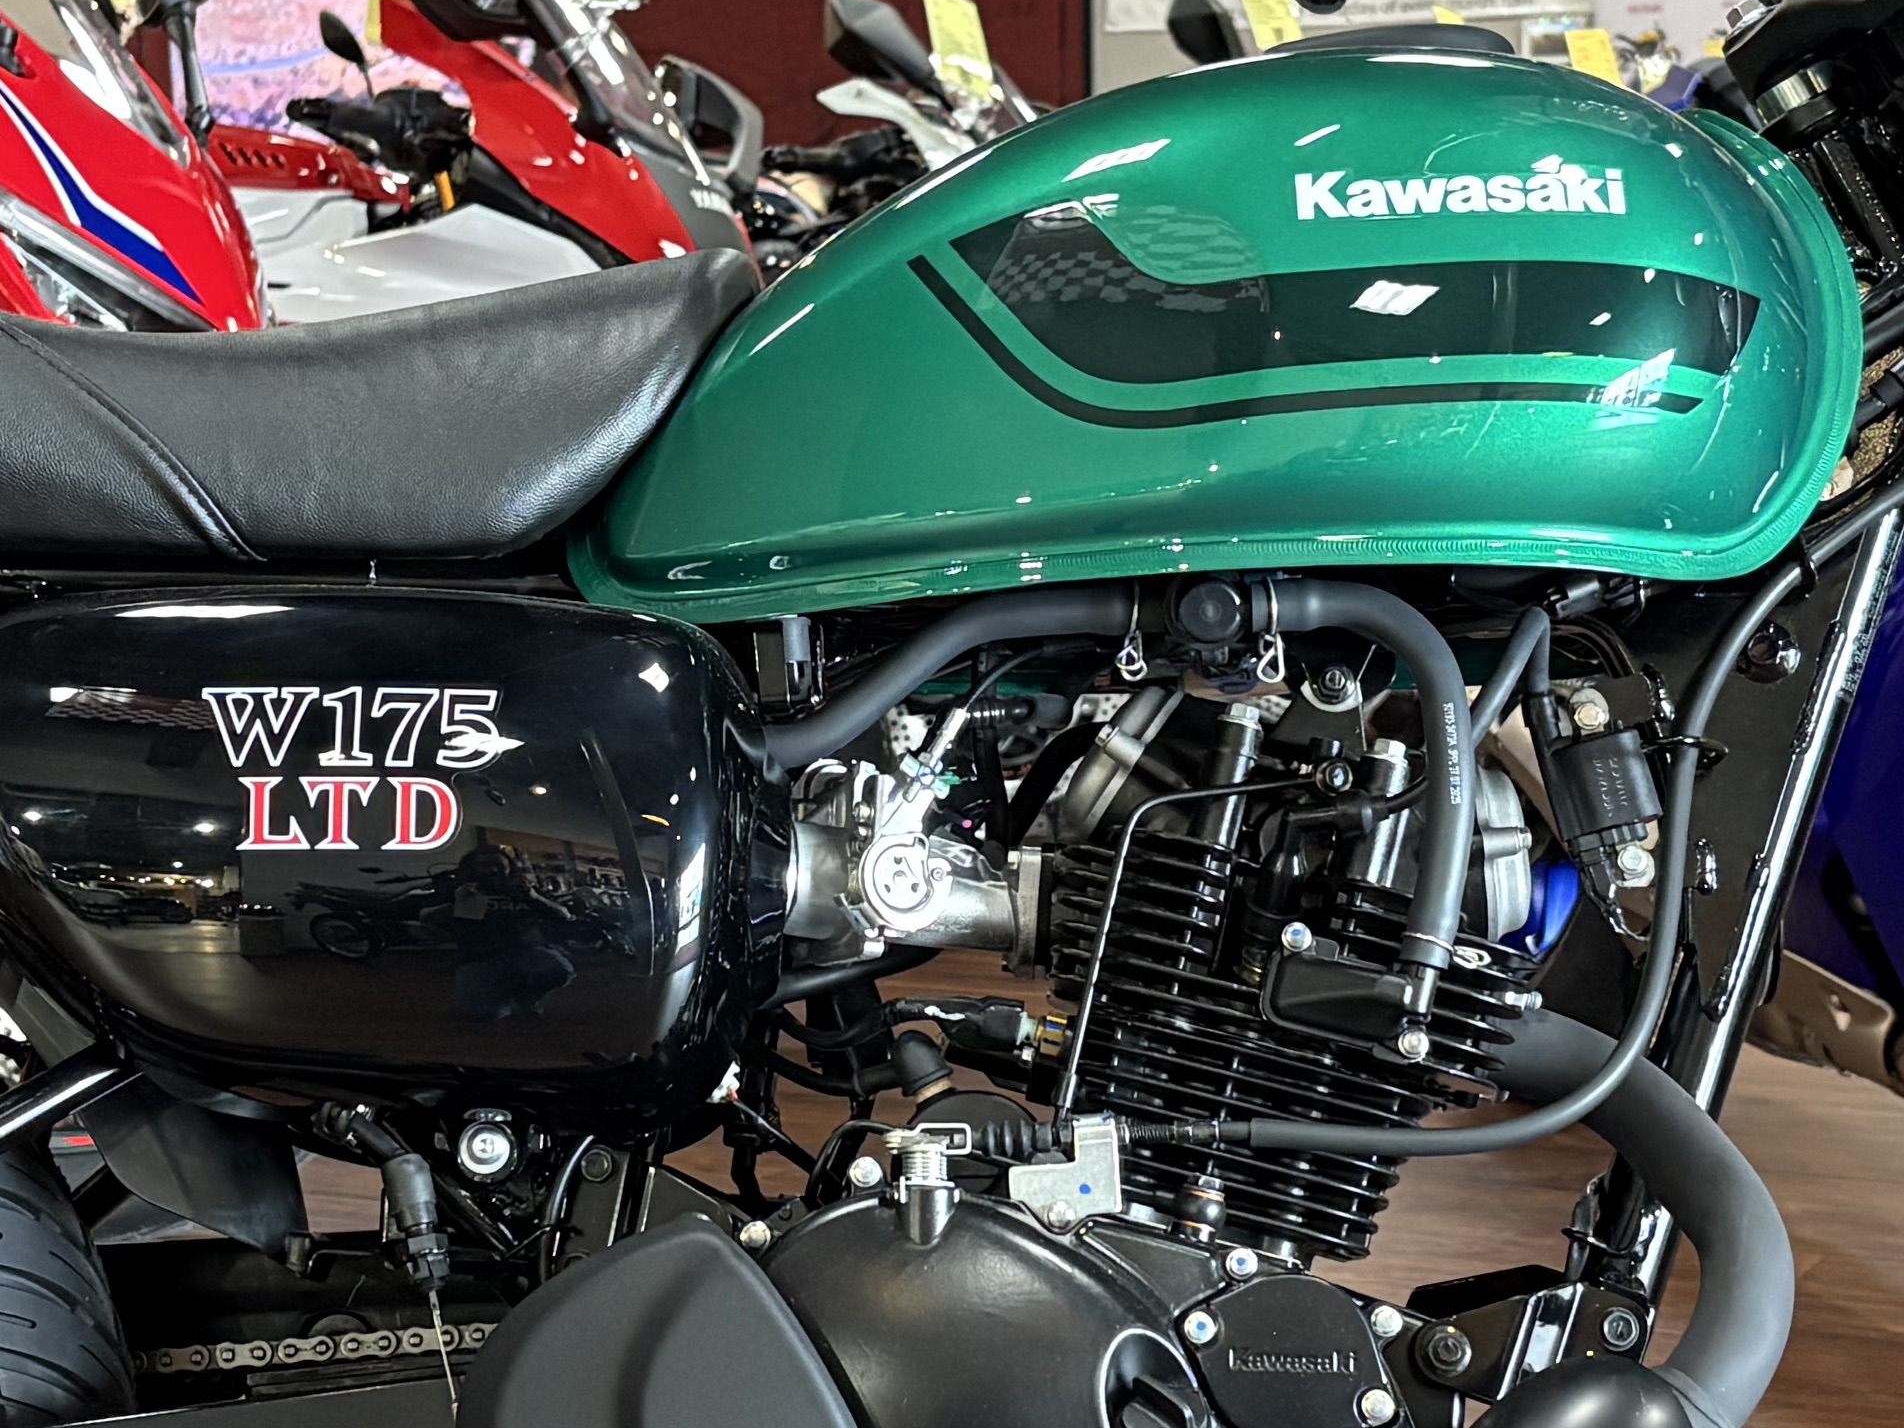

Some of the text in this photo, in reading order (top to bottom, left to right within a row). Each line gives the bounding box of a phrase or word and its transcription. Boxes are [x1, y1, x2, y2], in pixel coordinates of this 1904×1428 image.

[1295, 166, 1626, 221] Kawasaki
[201, 685, 501, 770] W175
[235, 775, 464, 851] LTD
[1228, 1345, 1358, 1376] Kawasaki
